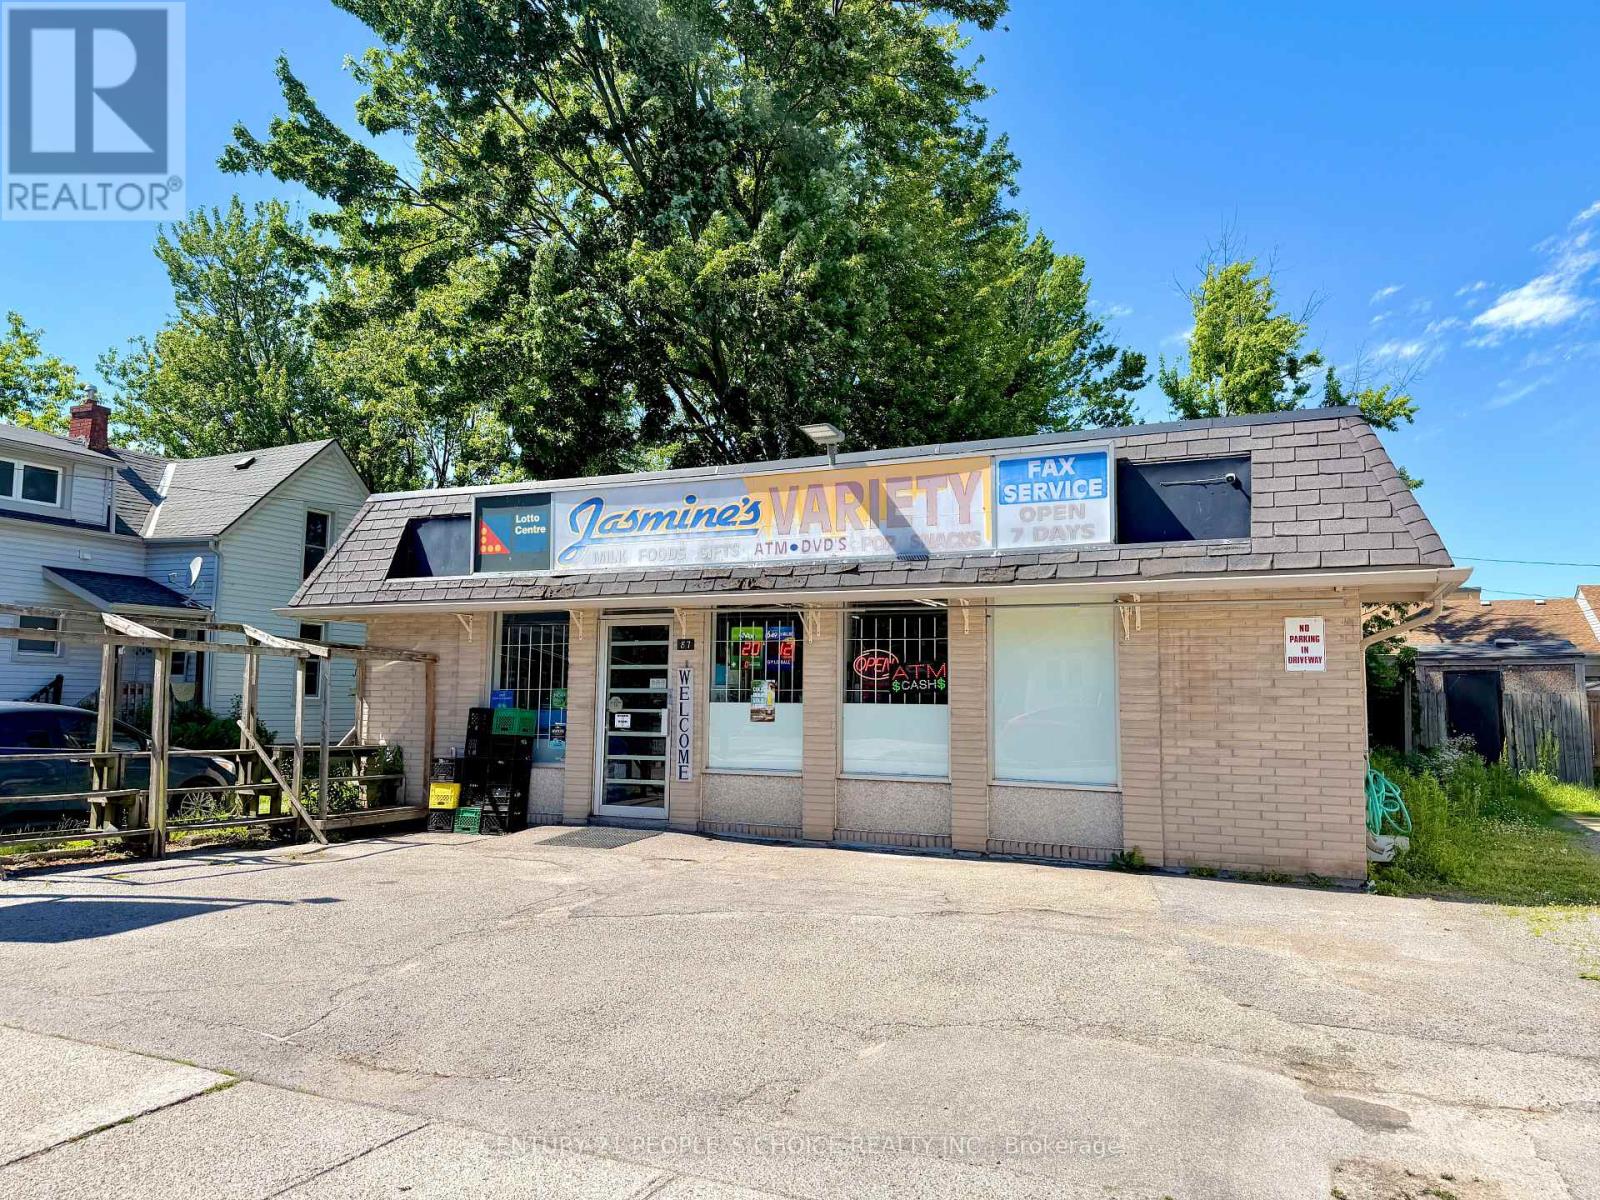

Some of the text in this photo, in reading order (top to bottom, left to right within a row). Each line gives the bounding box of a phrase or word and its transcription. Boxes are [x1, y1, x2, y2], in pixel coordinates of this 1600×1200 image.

[1028, 457, 1075, 479] FAX
[1003, 478, 1103, 503] SERVICE
[769, 471, 982, 536] VARIETY
[1019, 503, 1086, 523] OPEN
[515, 514, 540, 525] Lotto
[515, 524, 546, 536] Centre
[557, 494, 762, 567] Jasmine's
[1010, 523, 1096, 543] 7 DAYS
[755, 540, 788, 556] ATM
[801, 536, 848, 553] DVD'S
[909, 530, 982, 548] SNACKS
[1299, 624, 1310, 632] NO
[1289, 634, 1320, 643] PARKING
[1301, 646, 1309, 654] IN
[855, 657, 895, 673] OPEN
[1288, 656, 1323, 664] DRIVEWAY
[892, 662, 947, 681] ATM
[892, 677, 946, 692] $CASH$
[677, 669, 691, 781] WELCOME
